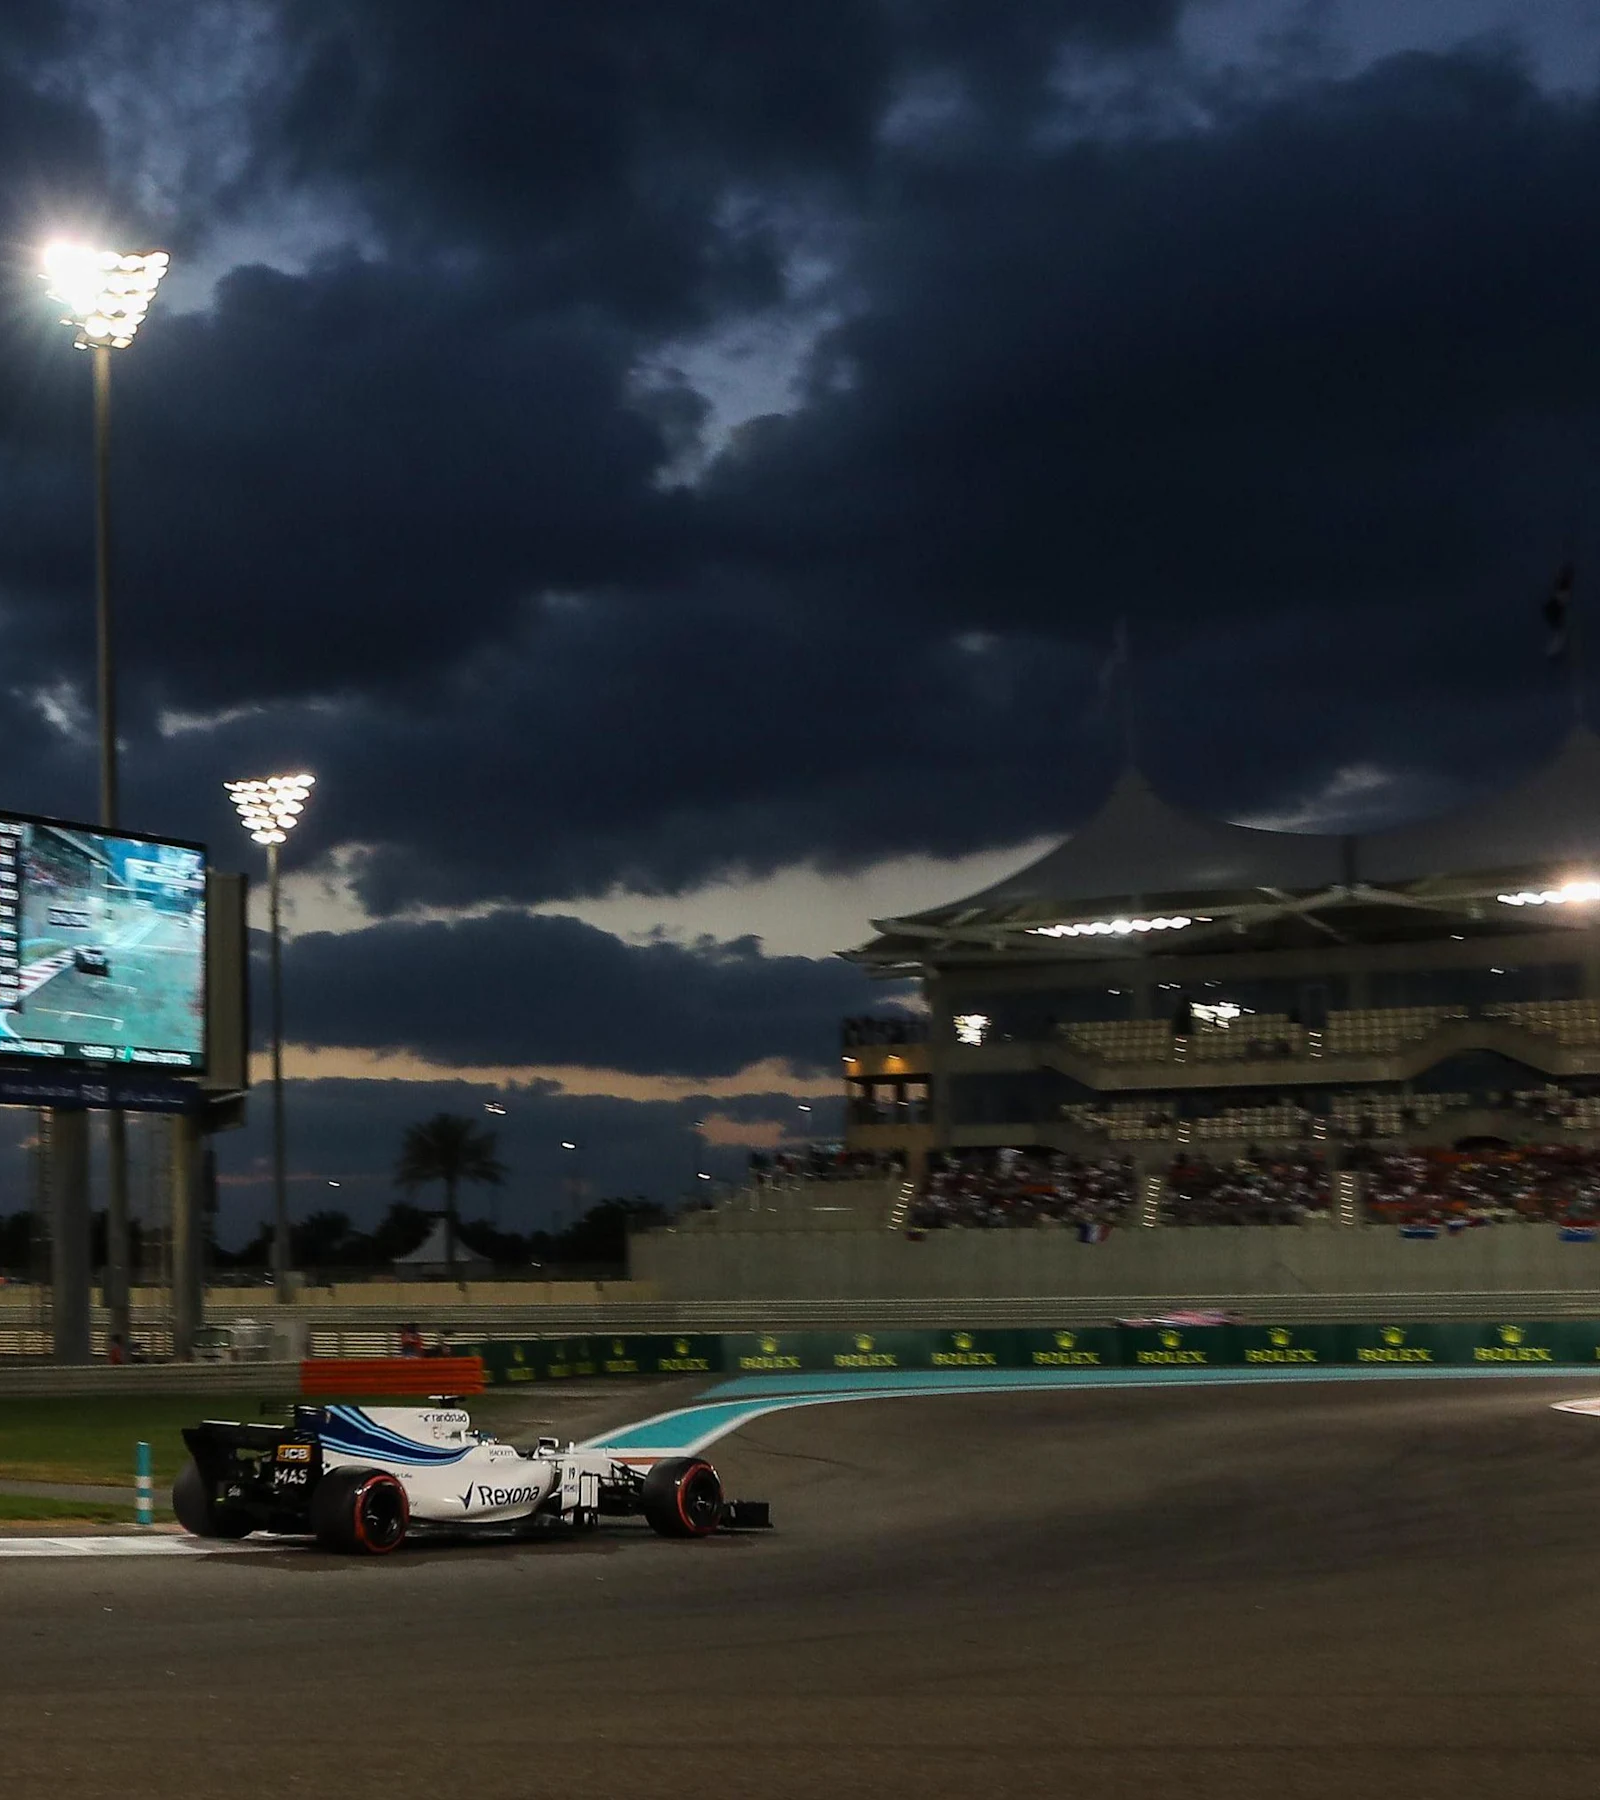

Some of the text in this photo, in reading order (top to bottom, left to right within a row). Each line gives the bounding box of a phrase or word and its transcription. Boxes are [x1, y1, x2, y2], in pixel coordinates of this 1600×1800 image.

[833, 1354, 898, 1367] ROLEX
[931, 1352, 997, 1366] ROLEX
[1032, 1351, 1101, 1365] ROLEX
[1137, 1350, 1208, 1364] ROLEX
[1244, 1349, 1318, 1363] ROLEX
[1357, 1348, 1433, 1362] ROLEX
[1473, 1347, 1553, 1361] ROLEX
[740, 1355, 801, 1369] ROLEX
[432, 1412, 468, 1423] randstad
[280, 1448, 309, 1460] JCB
[477, 1485, 541, 1506] Rexona
